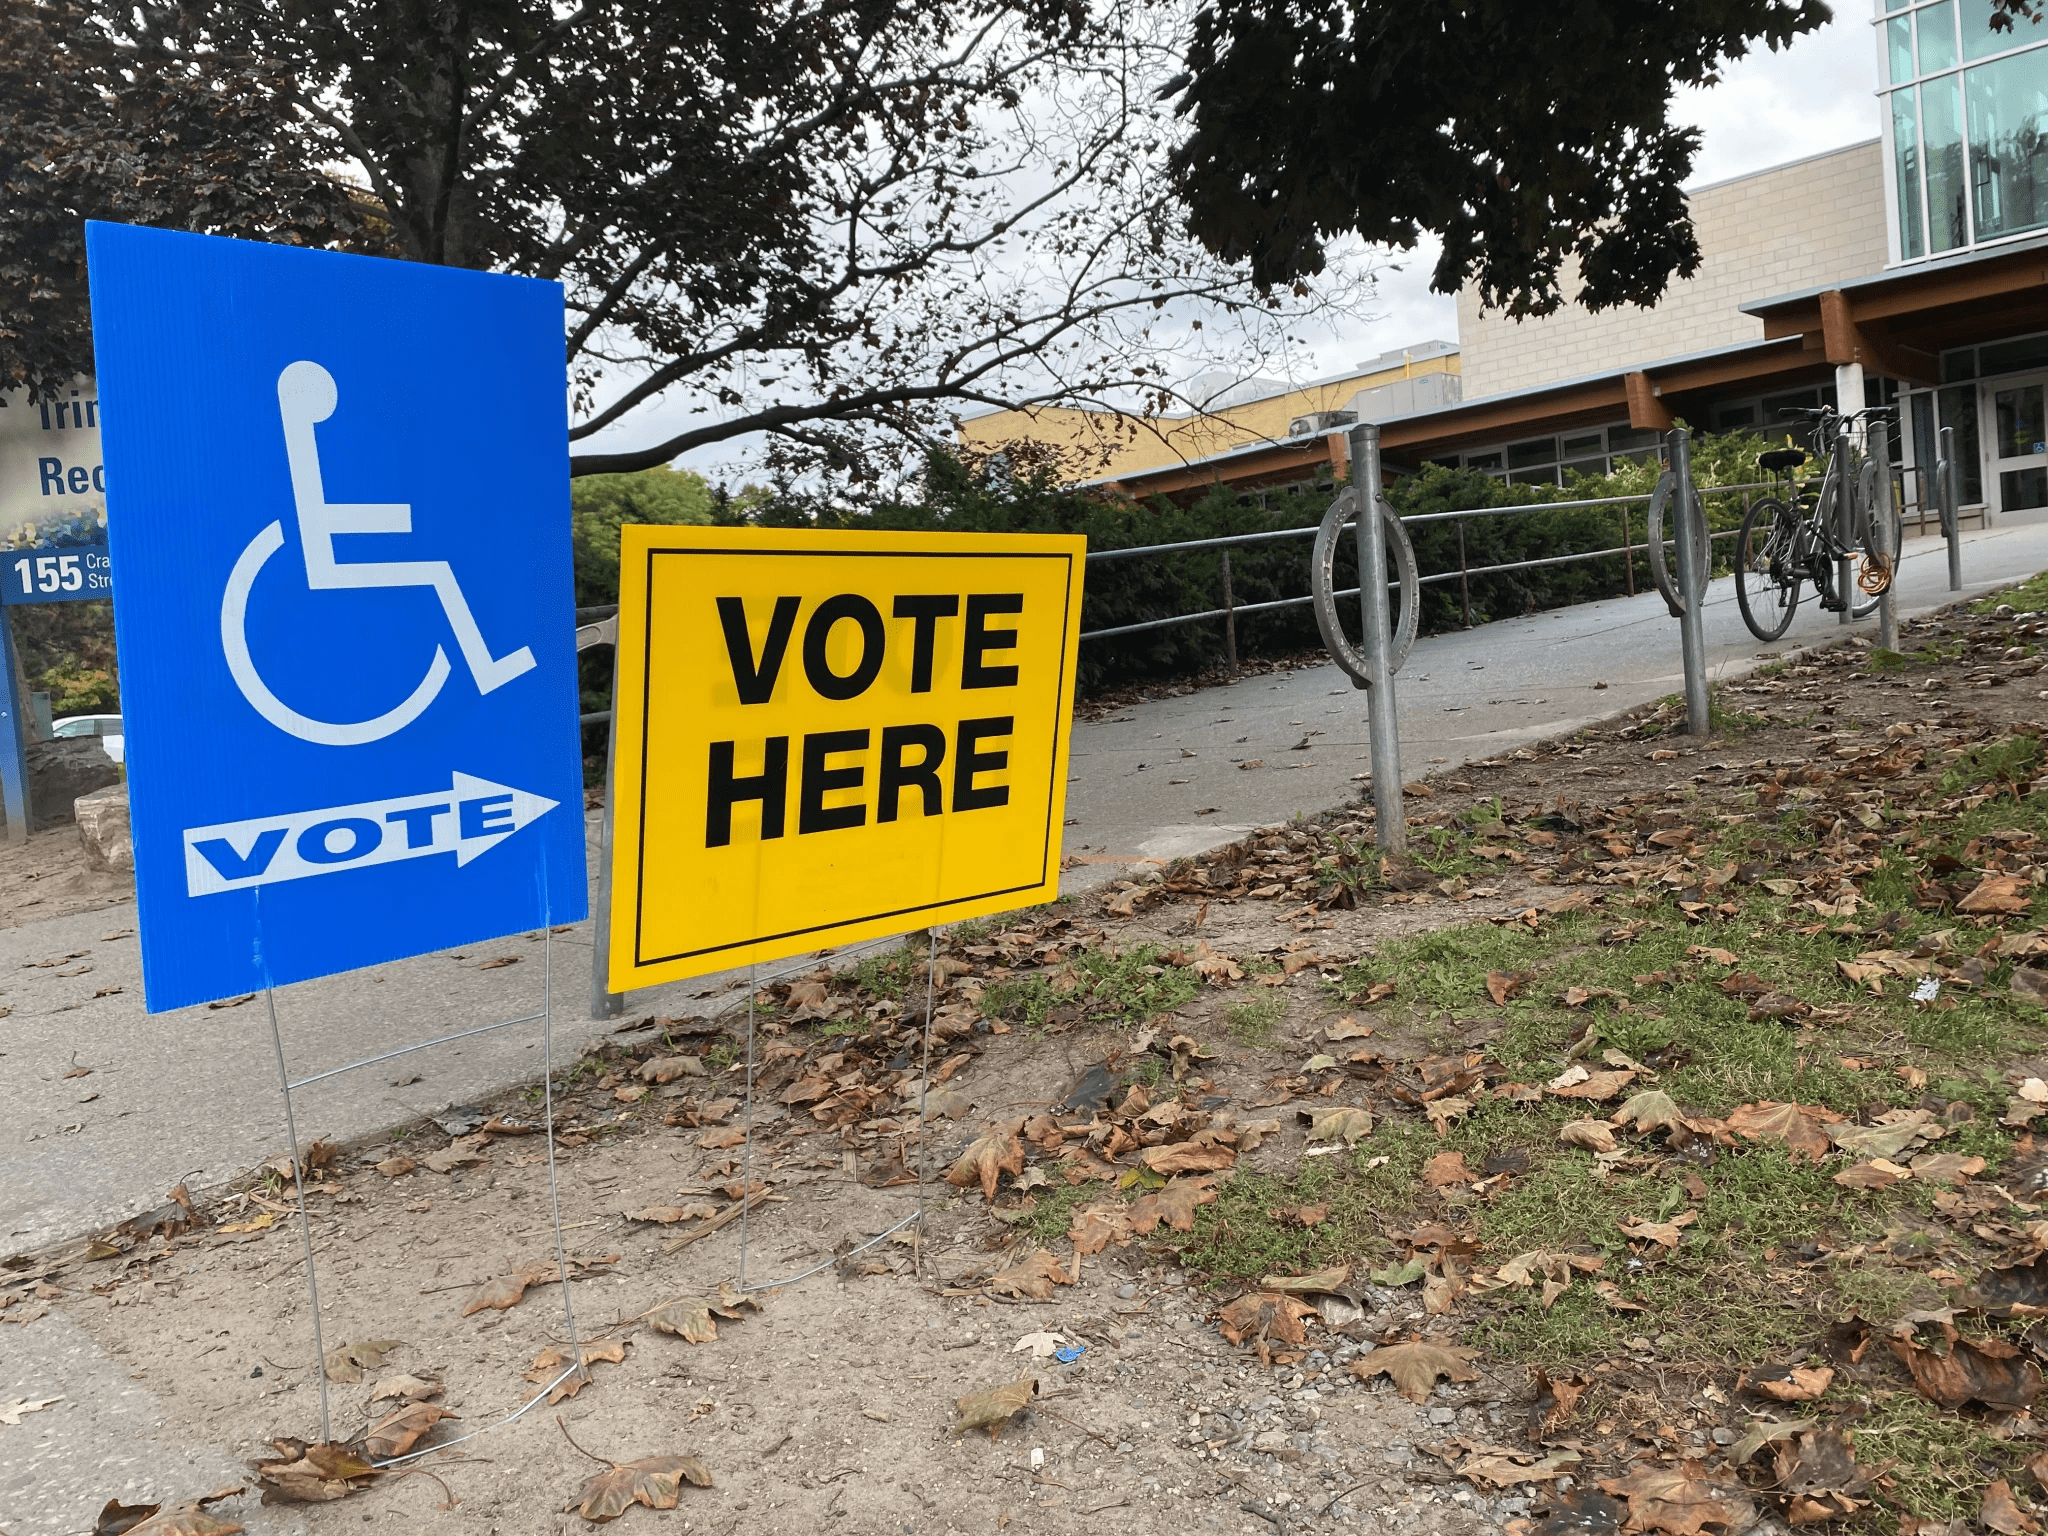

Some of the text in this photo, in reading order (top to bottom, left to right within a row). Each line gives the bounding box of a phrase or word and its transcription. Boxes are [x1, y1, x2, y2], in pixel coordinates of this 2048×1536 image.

[14, 555, 83, 594] 155
[86, 553, 110, 569] Cra
[714, 593, 1024, 706] VOTE
[705, 716, 1015, 849] HERE
[191, 793, 516, 881] VOTE
